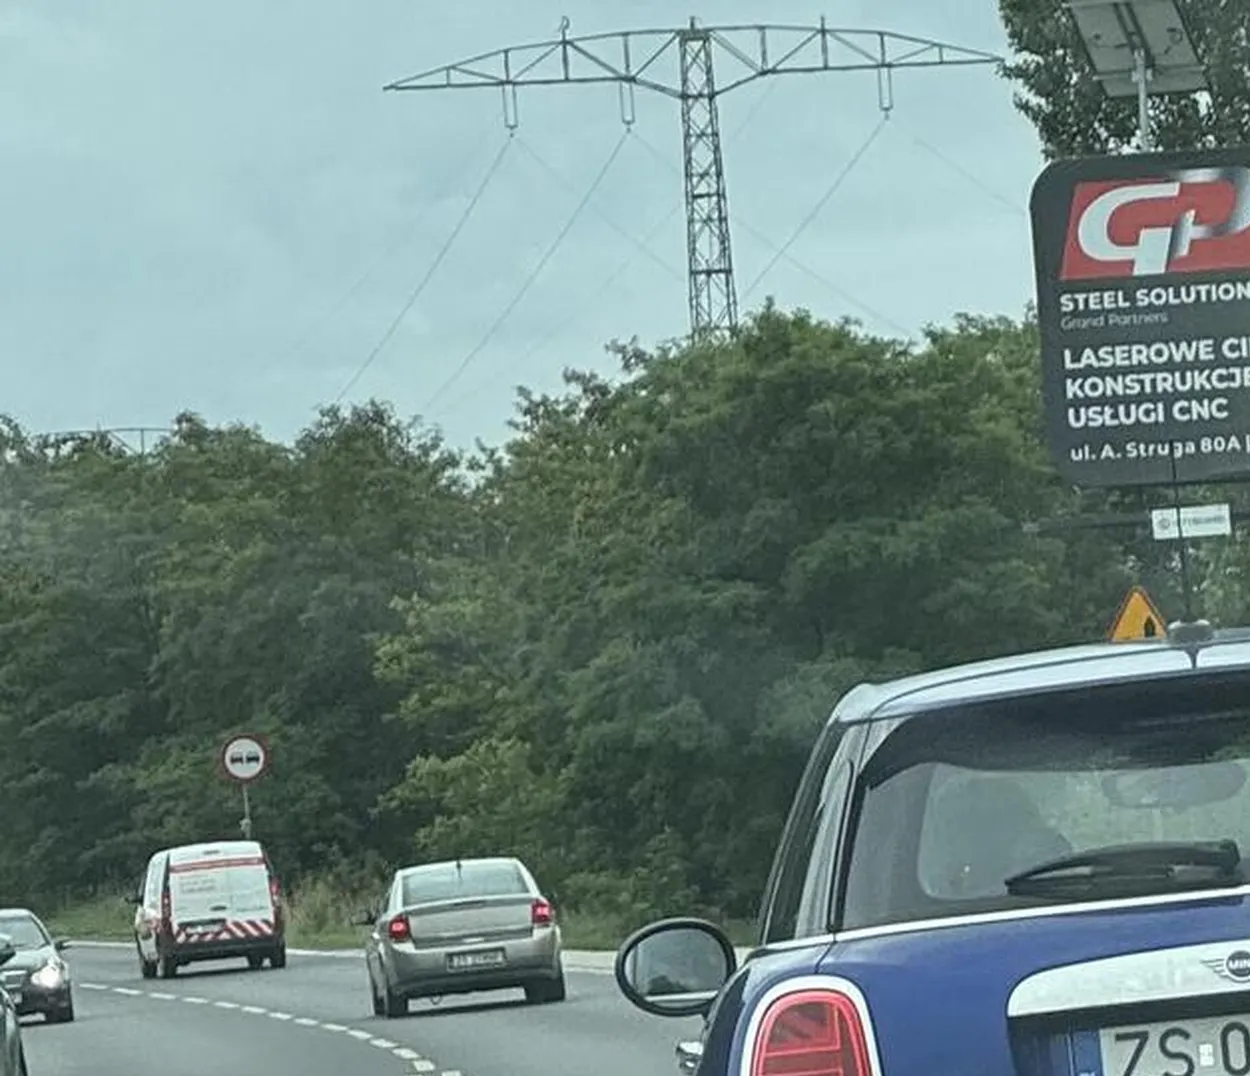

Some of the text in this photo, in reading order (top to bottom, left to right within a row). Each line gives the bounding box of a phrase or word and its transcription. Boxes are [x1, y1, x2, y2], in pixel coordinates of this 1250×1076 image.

[1060, 290, 1131, 312] STEEL
[1060, 312, 1169, 330] Grand Partners
[1064, 339, 1214, 369] LASEROWE
[1067, 398, 1229, 428] USŁUGI CNC
[1070, 445, 1096, 461] ul.
[1100, 444, 1122, 459] A.
[1126, 439, 1196, 459] Struga
[1200, 435, 1242, 453] 80A
